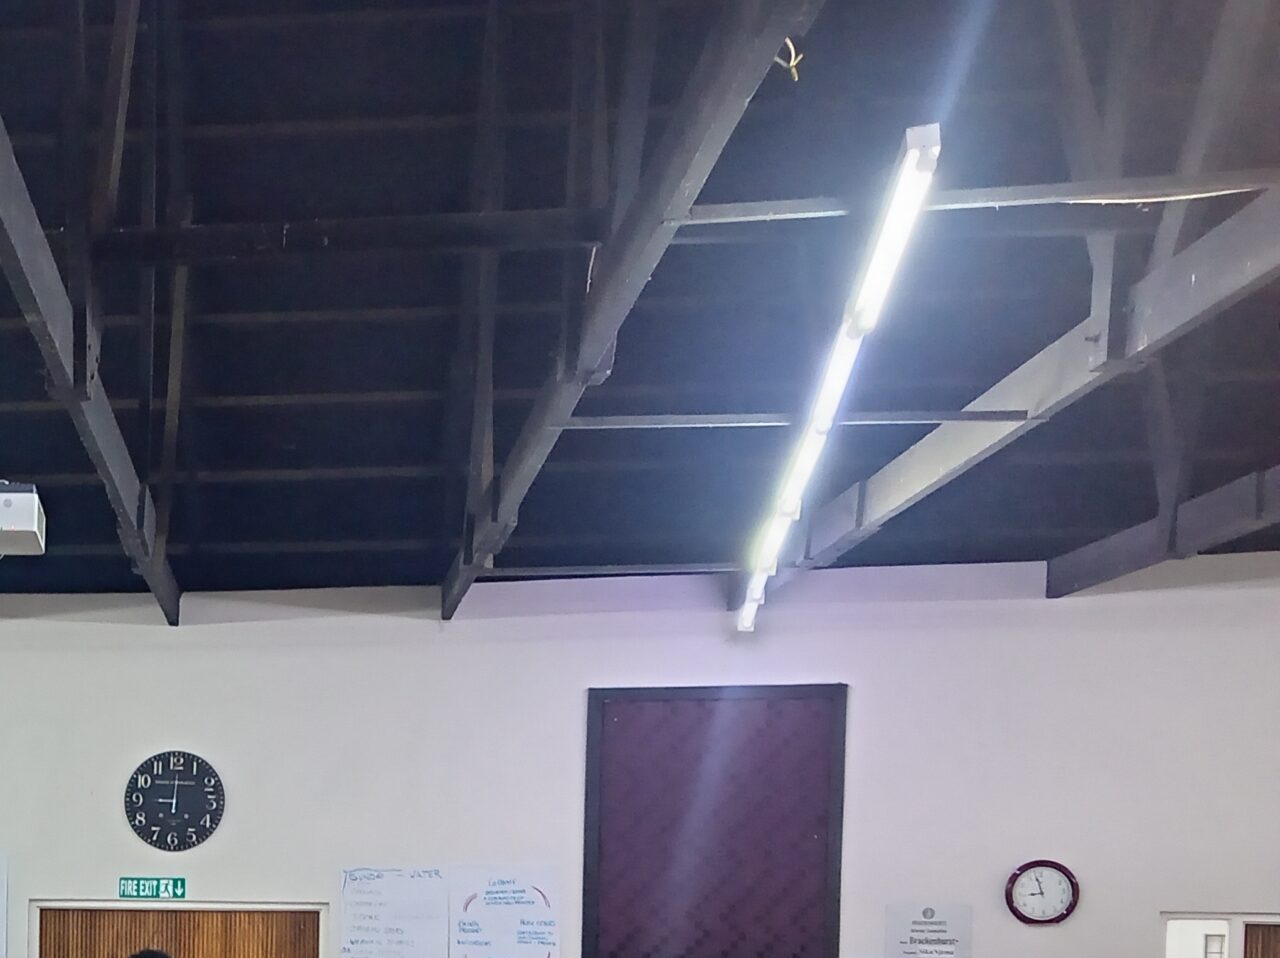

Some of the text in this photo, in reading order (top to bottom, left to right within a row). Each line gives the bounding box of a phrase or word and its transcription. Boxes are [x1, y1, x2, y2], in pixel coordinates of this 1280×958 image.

[153, 761, 162, 775] 11
[170, 756, 184, 770] 12
[138, 774, 151, 788] 10
[204, 777, 215, 791] 2
[132, 792, 143, 806] 9
[135, 812, 145, 825] 8
[200, 814, 210, 828] 4
[151, 827, 160, 840] 7
[167, 832, 178, 846] 6
[186, 828, 196, 842] 5
[120, 880, 158, 896] FIRE EXIT
